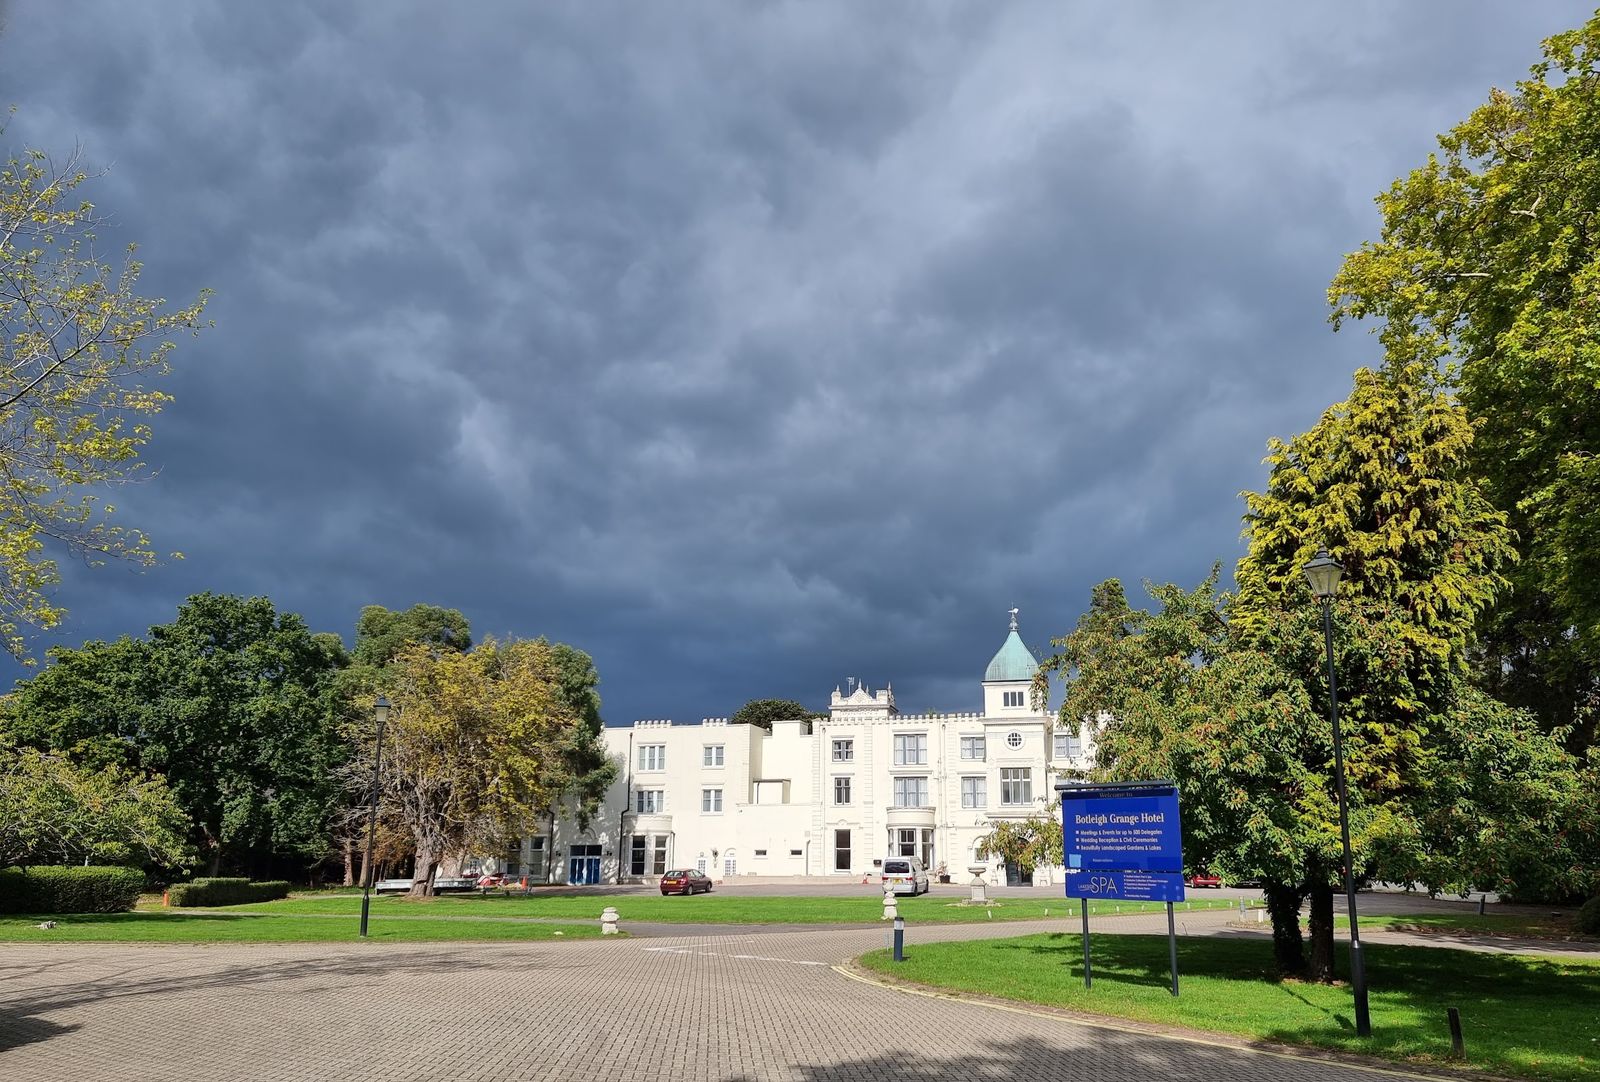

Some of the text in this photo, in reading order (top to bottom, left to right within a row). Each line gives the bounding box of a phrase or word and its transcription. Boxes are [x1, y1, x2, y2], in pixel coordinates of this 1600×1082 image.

[1075, 812, 1164, 826] Botleigh Grange Hotel
[1091, 876, 1118, 894] SPA
